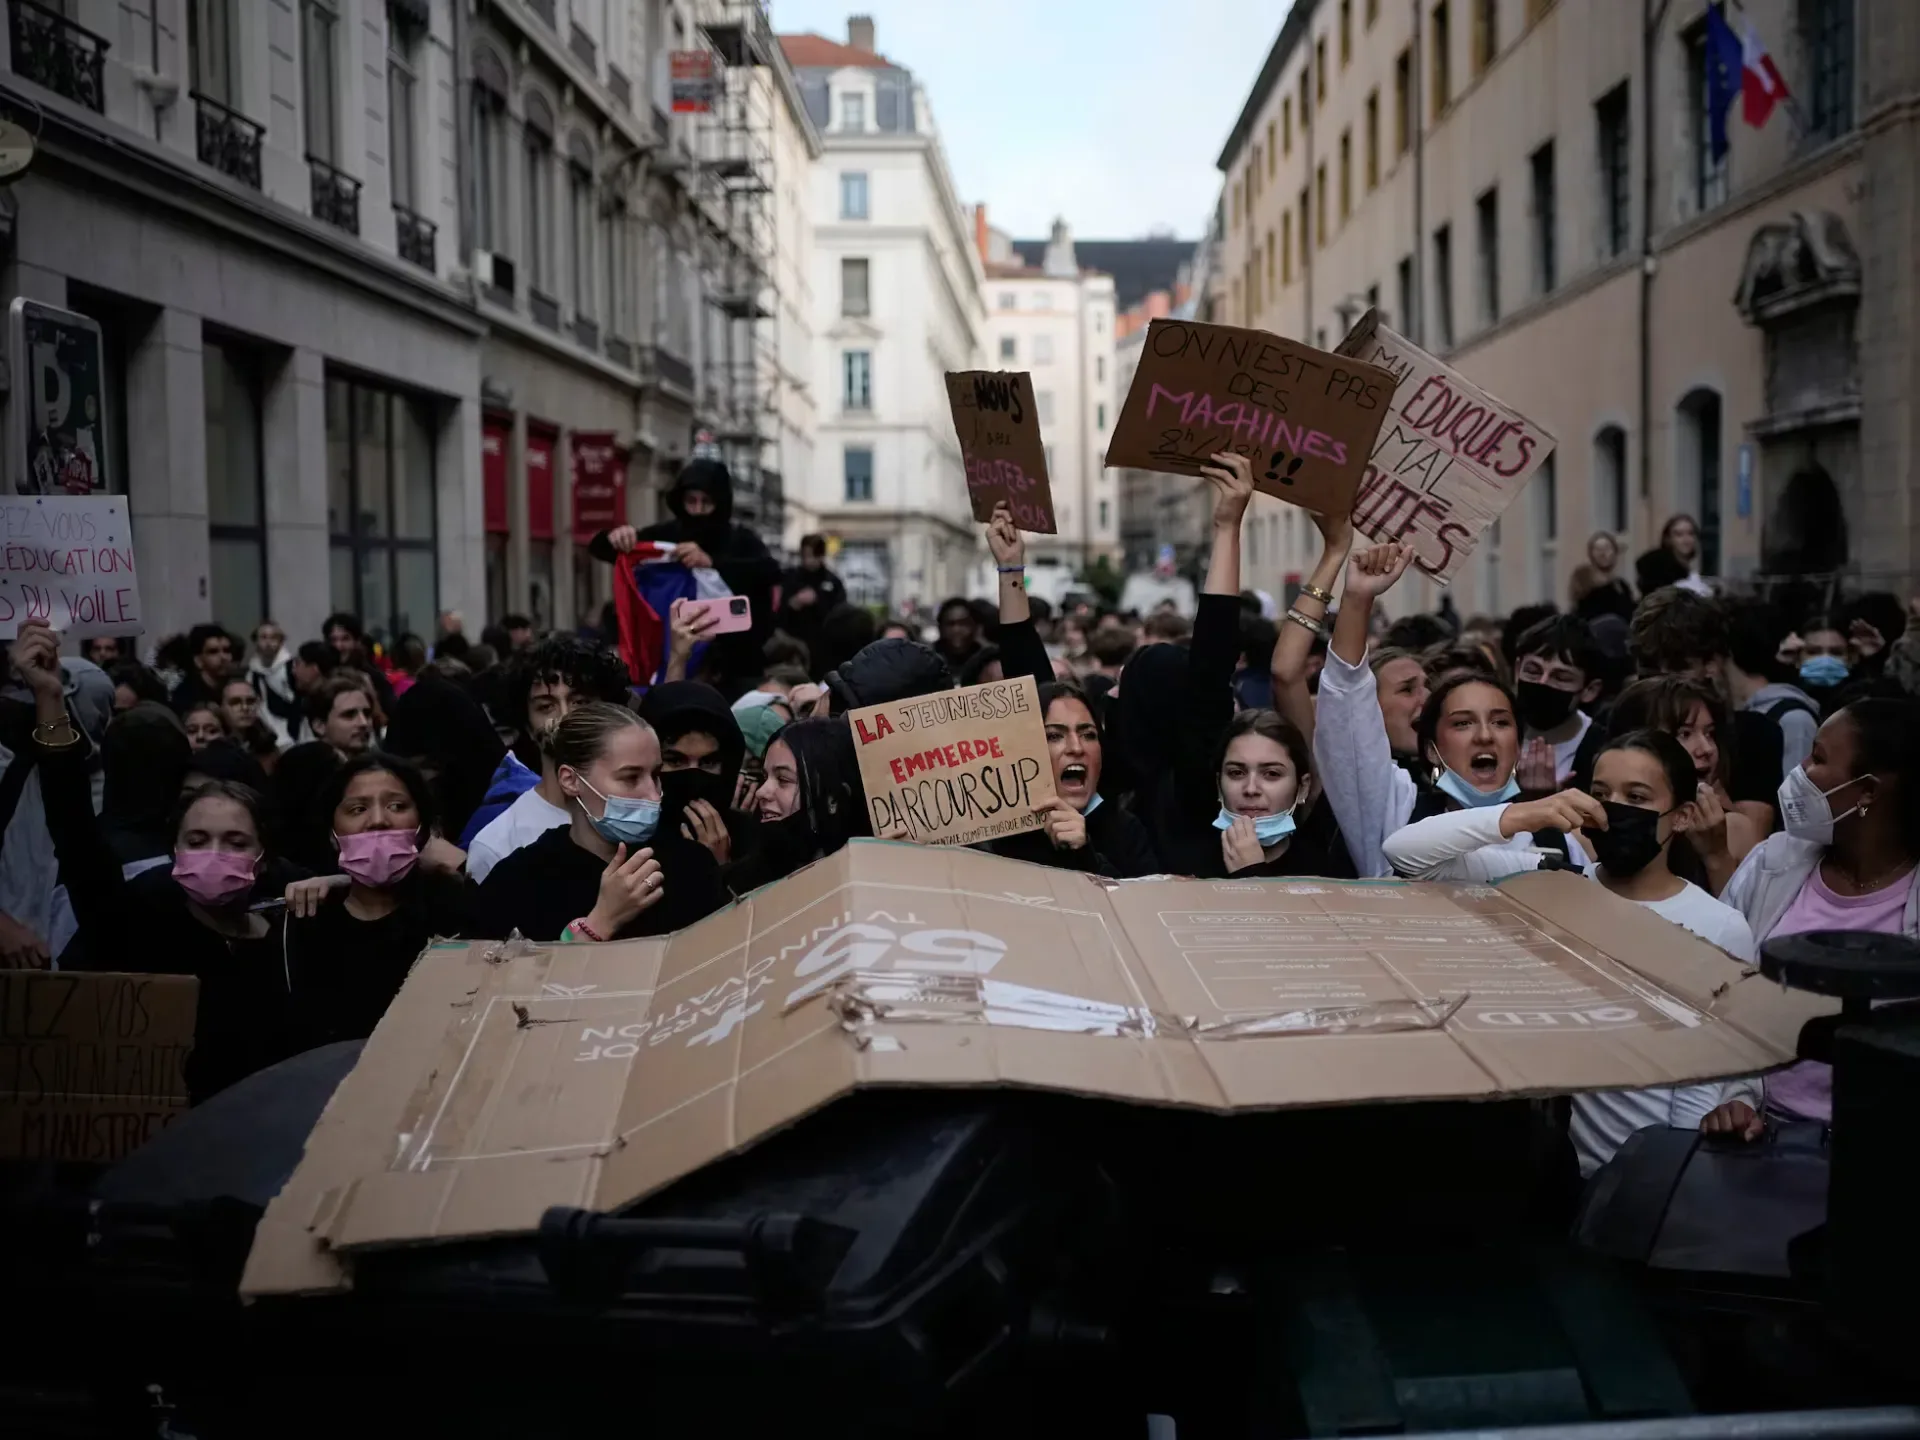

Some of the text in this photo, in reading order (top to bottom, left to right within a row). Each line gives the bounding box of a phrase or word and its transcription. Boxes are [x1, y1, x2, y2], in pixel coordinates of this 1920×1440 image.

[1153, 324, 1213, 360] ON
[1325, 368, 1378, 410] PAS
[974, 374, 1023, 424] NOUS
[1227, 372, 1290, 414] DES
[1147, 382, 1347, 465] MACHINES
[20, 584, 51, 619] DU
[855, 684, 1030, 746] LA JEUNESSE
[889, 736, 1005, 785] EMMERDE
[871, 757, 1040, 841] PARCOURSUP
[866, 909, 928, 926] TV
[1477, 1005, 1639, 1027] QLED
[574, 1043, 641, 1062] OF
